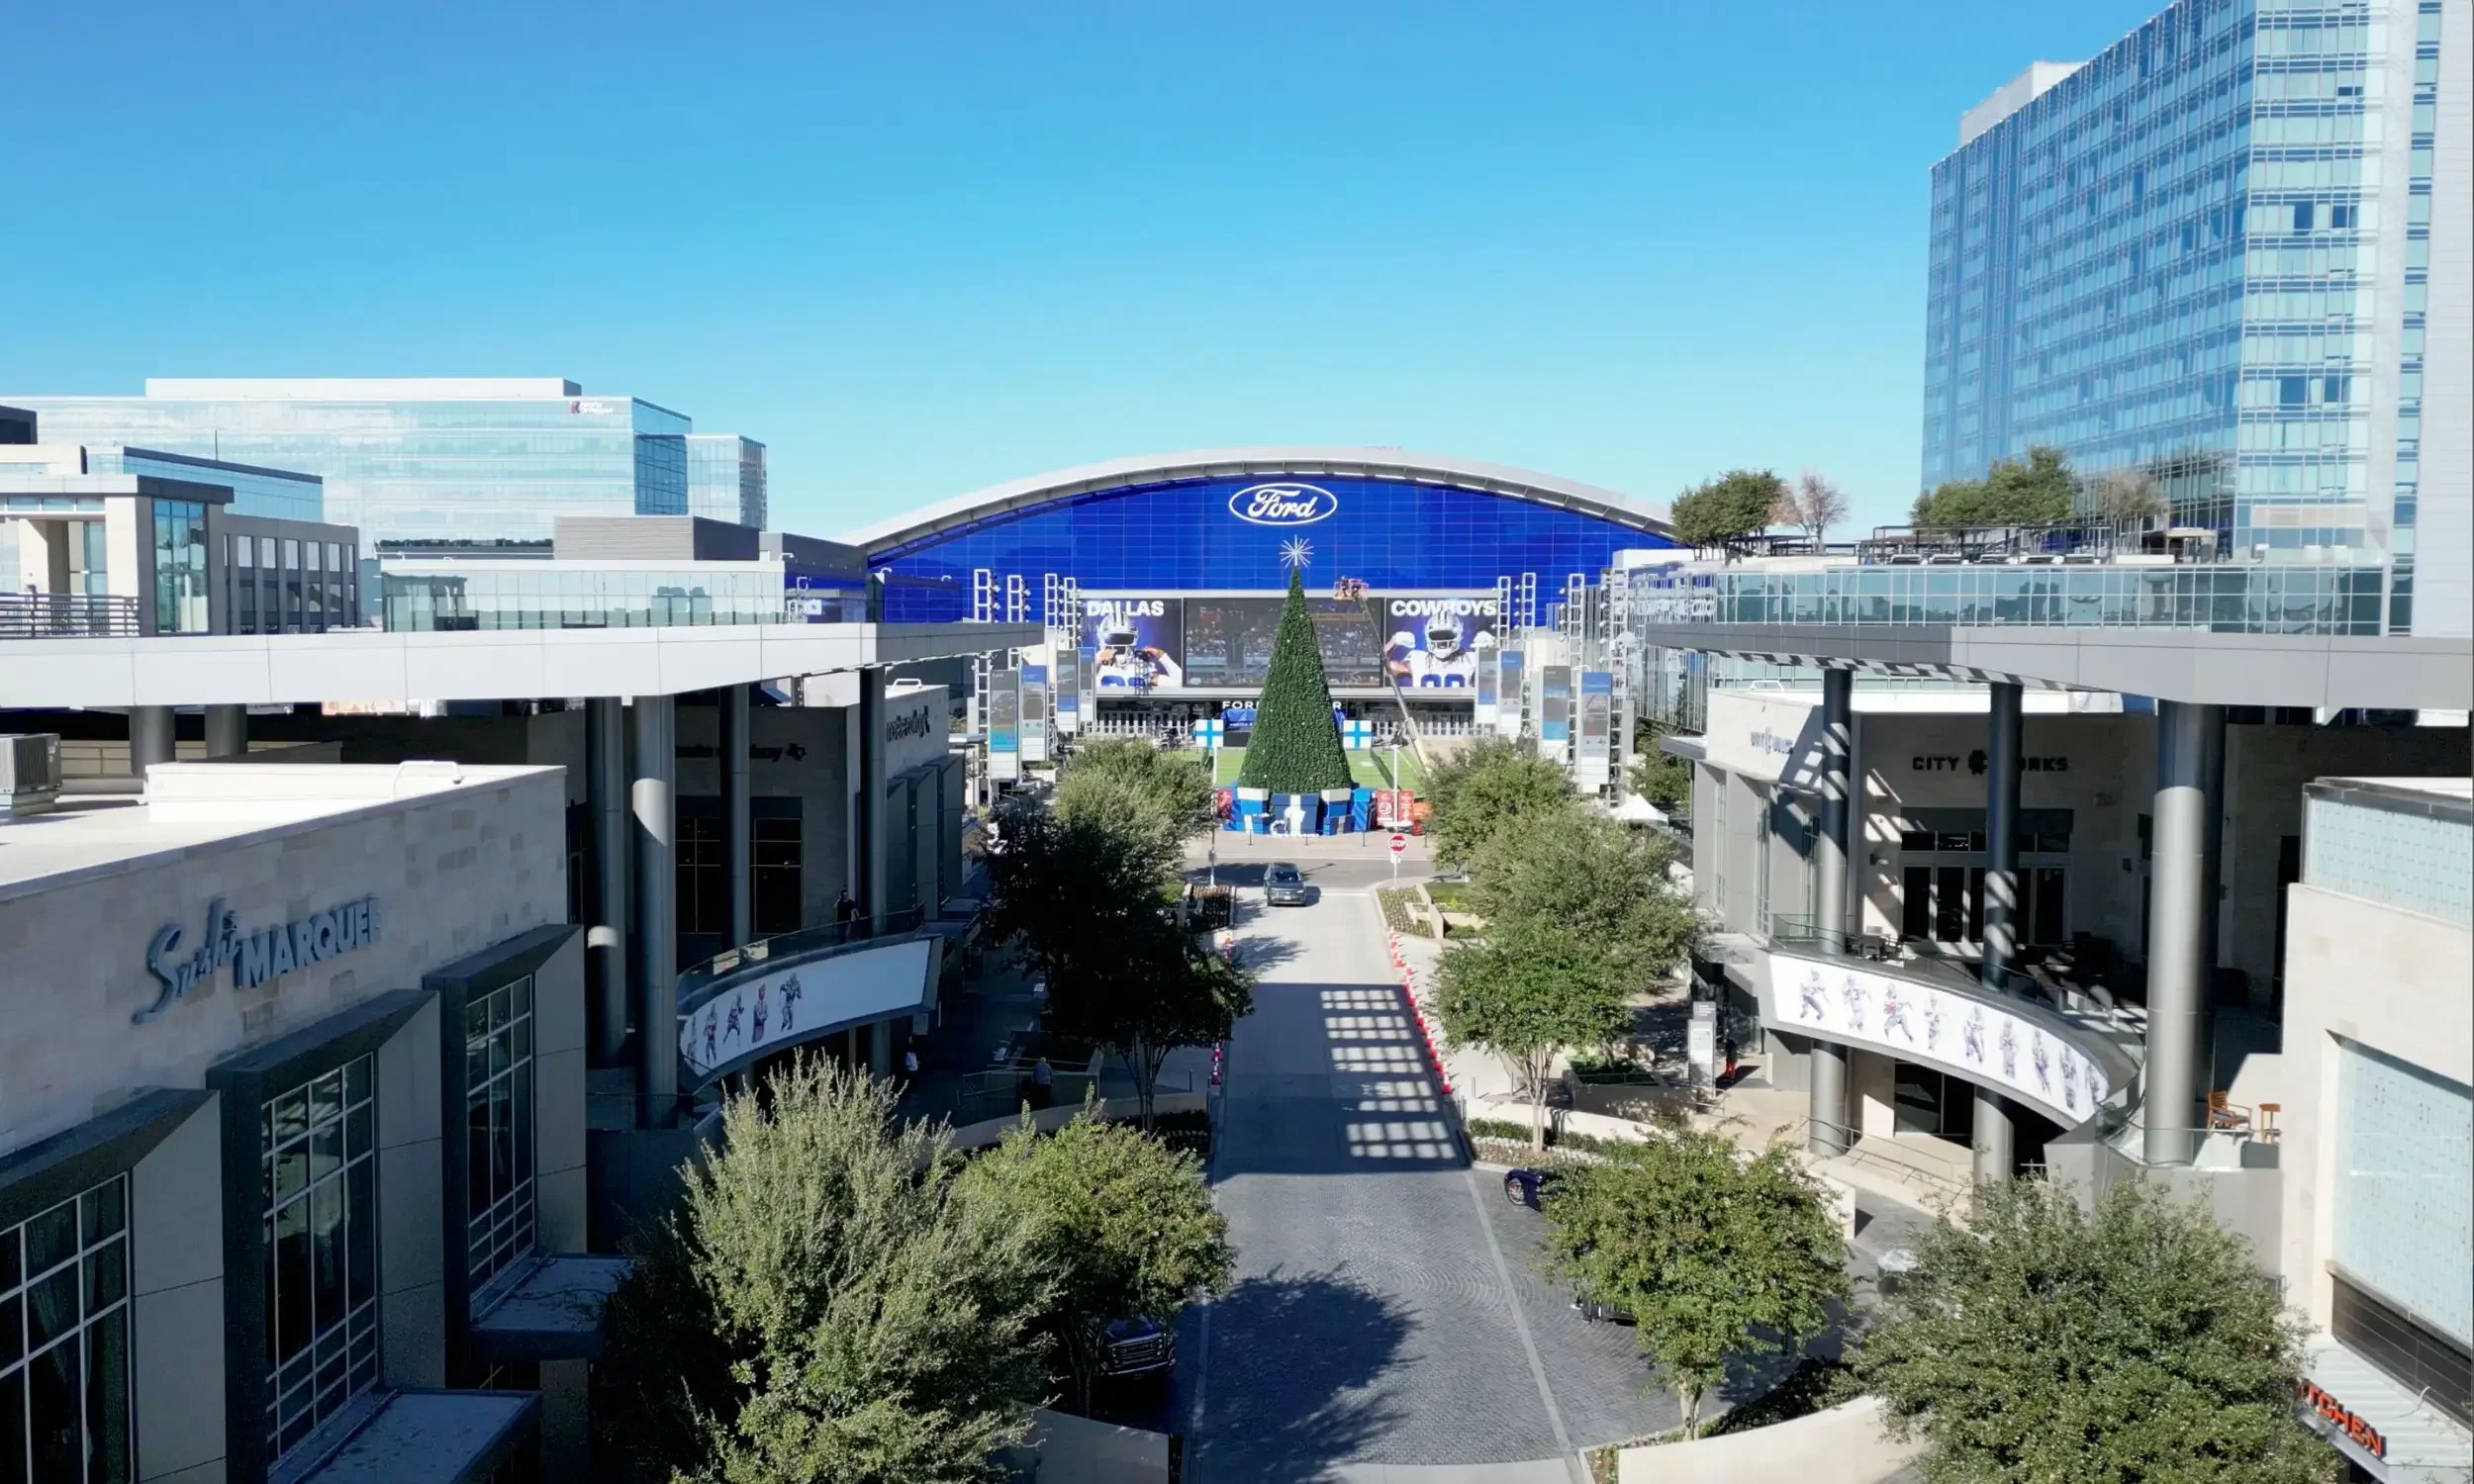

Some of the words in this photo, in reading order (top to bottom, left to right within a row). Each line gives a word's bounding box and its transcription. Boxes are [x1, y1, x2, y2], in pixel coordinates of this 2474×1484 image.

[1248, 488, 1319, 518] Ford
[1087, 600, 1165, 616] DALLAS
[1390, 600, 1497, 616] COWBOYS
[1914, 757, 1959, 771] CITY
[2023, 757, 2068, 771] RKS
[236, 894, 381, 989] MARQUEE
[2299, 1378, 2384, 1457] TCHEN
